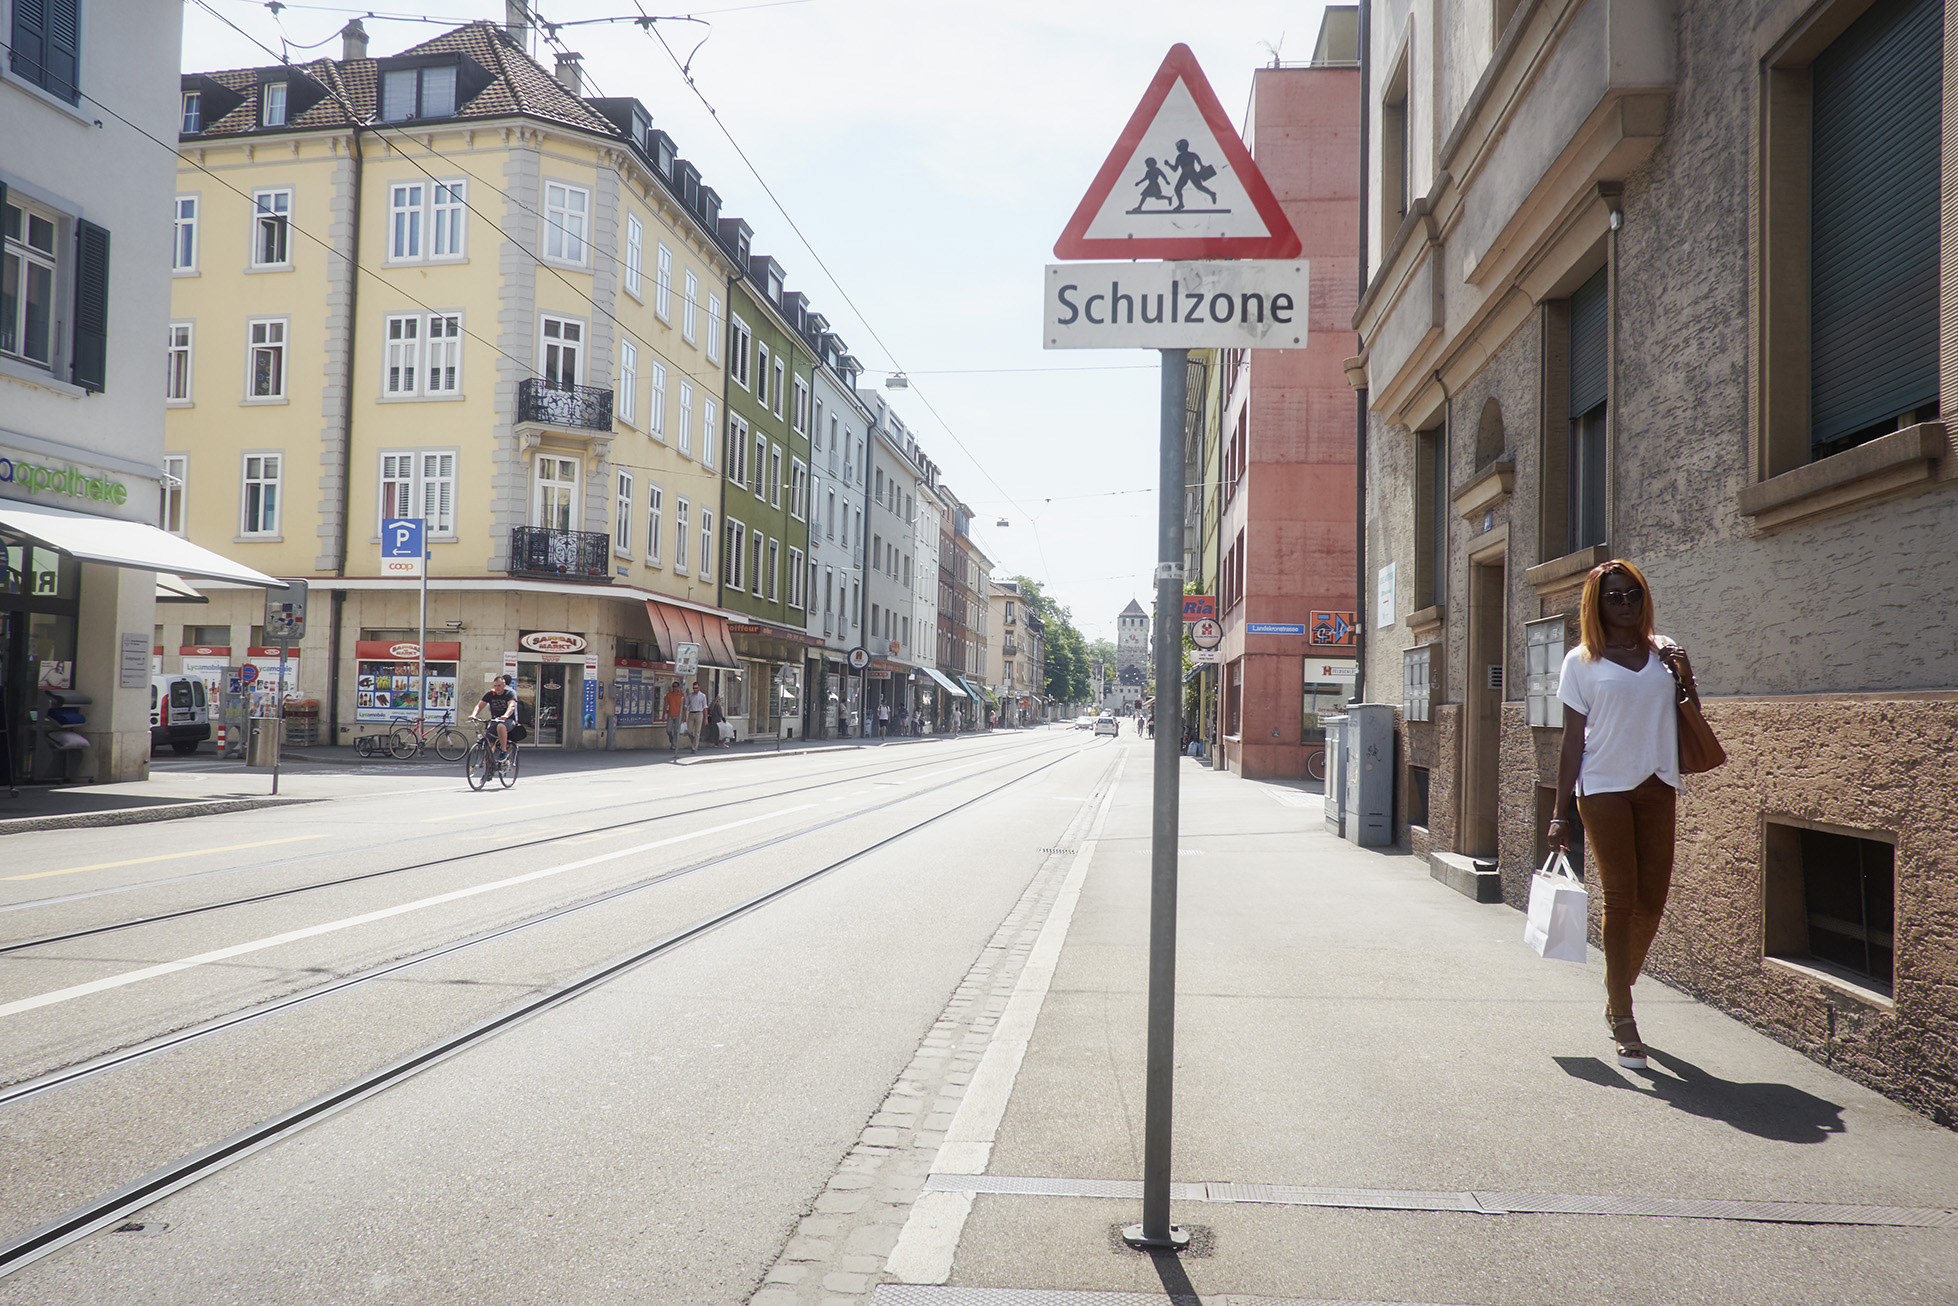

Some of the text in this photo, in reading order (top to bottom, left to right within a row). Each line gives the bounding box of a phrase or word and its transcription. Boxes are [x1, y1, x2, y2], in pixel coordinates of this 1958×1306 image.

[1057, 280, 1294, 325] Schulzone
[396, 529, 410, 547] P
[389, 562, 414, 571] coop
[1183, 598, 1212, 614] Ria
[728, 624, 759, 632] oiffeur
